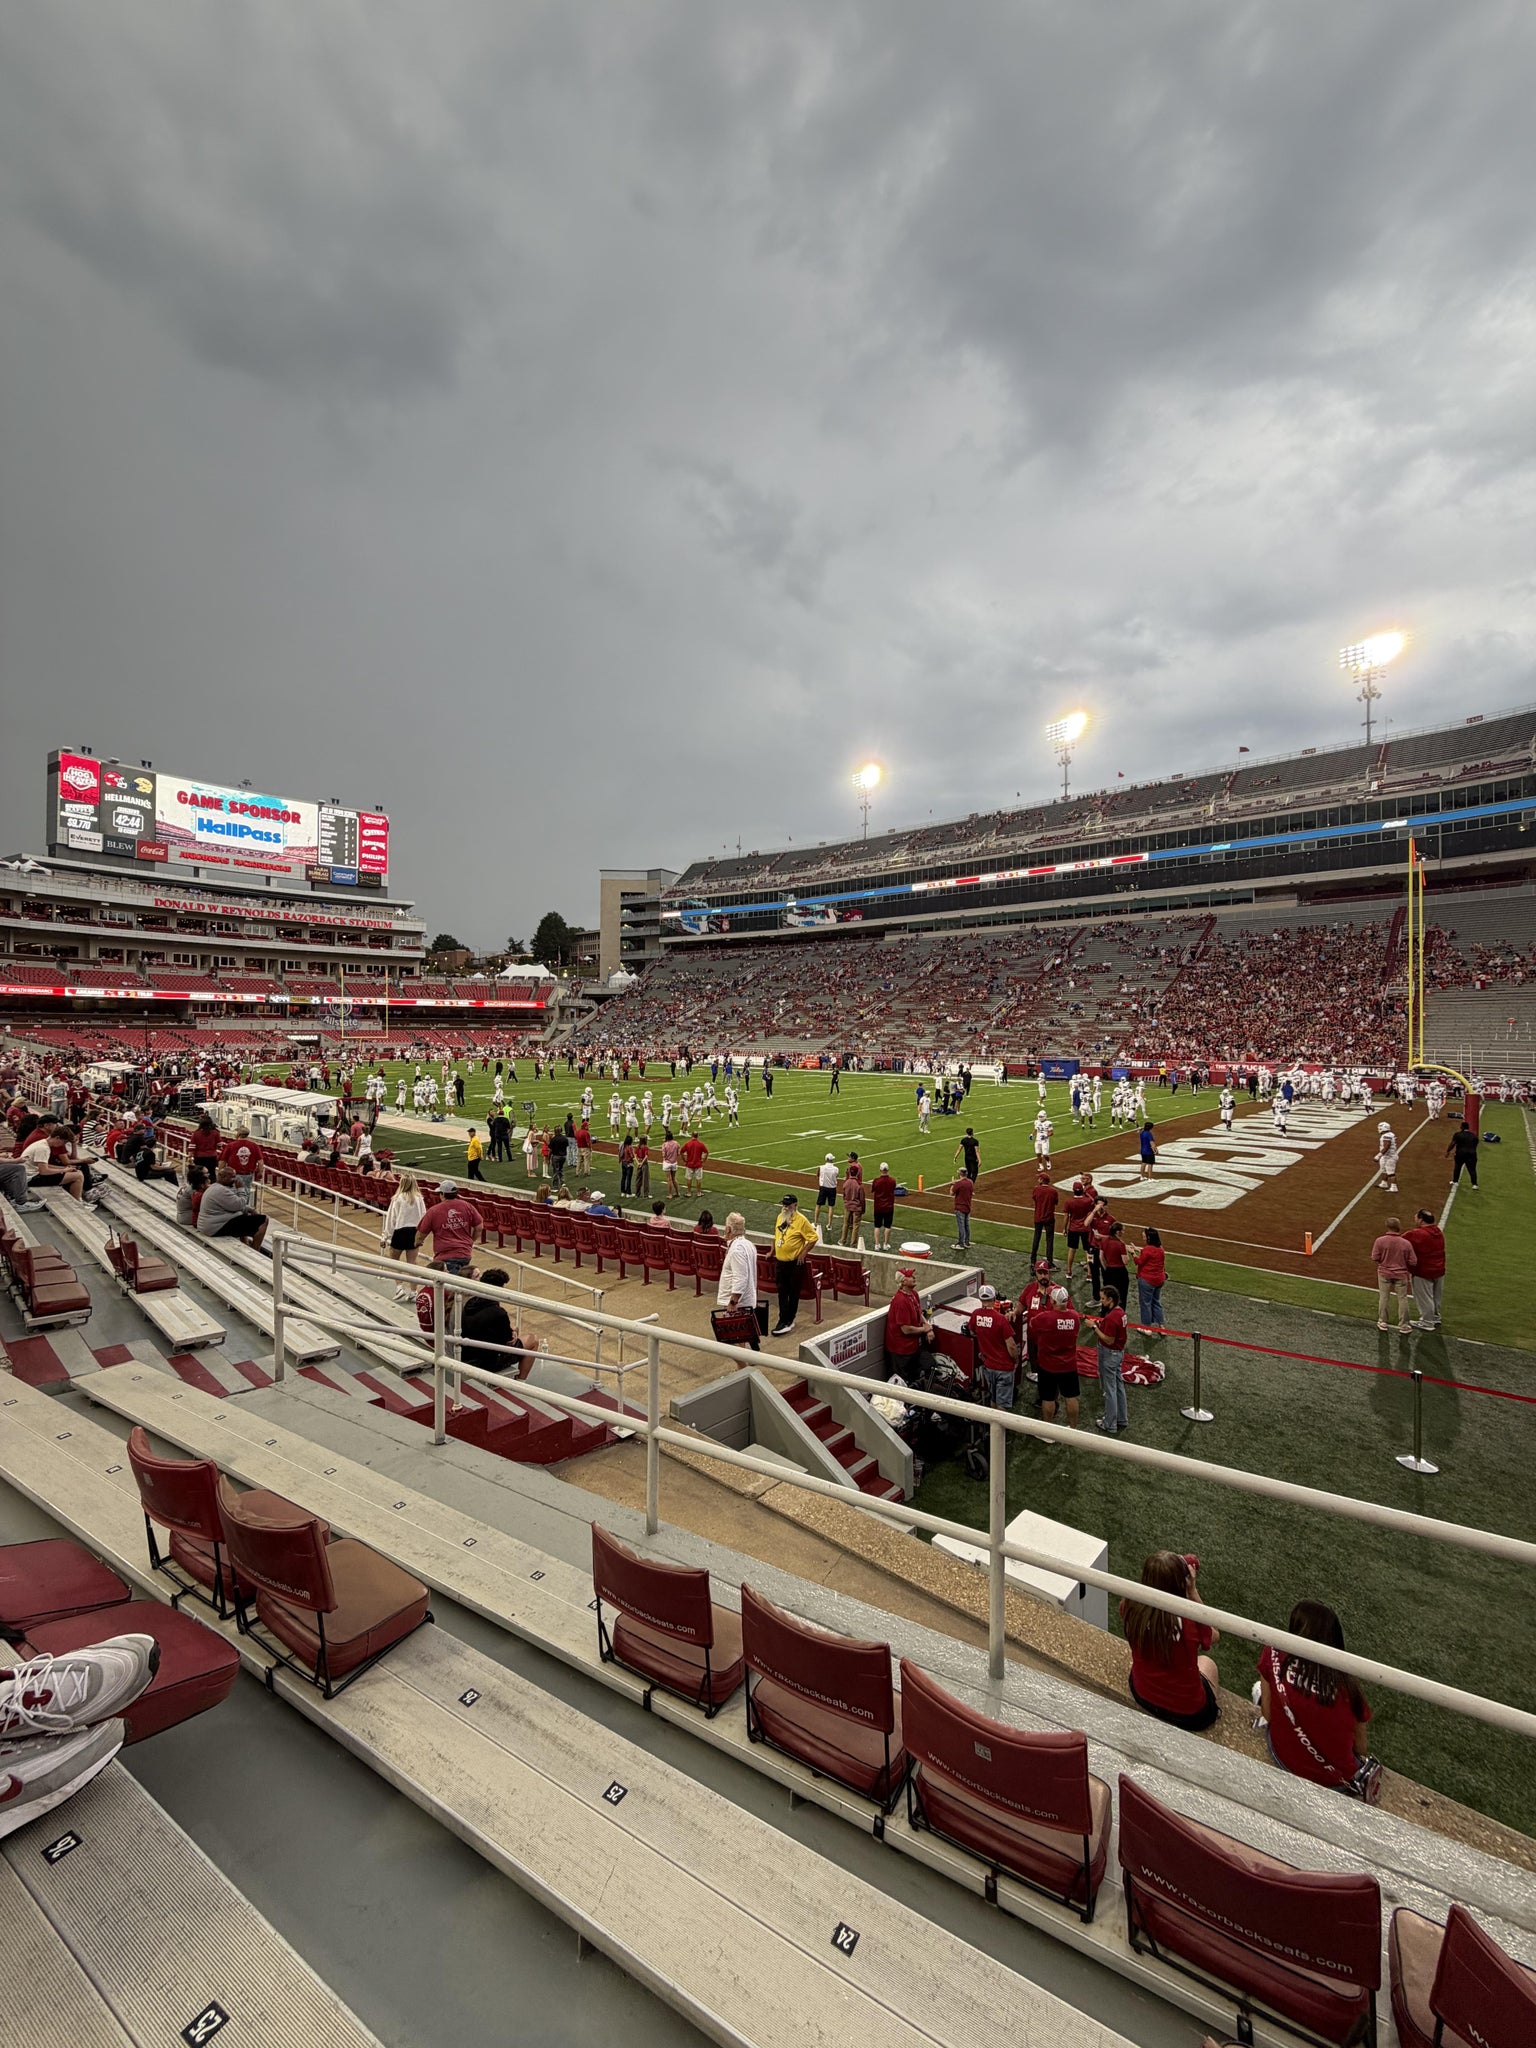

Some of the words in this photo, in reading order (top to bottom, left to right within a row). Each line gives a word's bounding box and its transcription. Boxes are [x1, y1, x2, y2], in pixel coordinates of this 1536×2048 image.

[65, 774, 96, 786] HEAVEN
[71, 769, 90, 779] HOG
[177, 791, 223, 811] GAME
[229, 800, 301, 824] SPONSOR
[116, 814, 140, 828] 42:44
[70, 833, 101, 843] EVERETT
[197, 817, 282, 844] HallPass
[106, 840, 134, 850] BLEW
[179, 851, 230, 864] ARKANSAS
[362, 853, 386, 861] PHILIPS
[154, 898, 206, 912] DONALD
[207, 904, 218, 913] W
[221, 906, 281, 919] REYNOLDS
[283, 912, 347, 926] RAZORBACK
[349, 918, 392, 929] STADIUM
[323, 1015, 358, 1028] Allstate
[976, 1315, 993, 1323] PYRO
[1056, 1318, 1075, 1326] PYRO
[600, 1585, 696, 1636] www.razorbackseats.com
[752, 1653, 875, 1720] www.razorbackseats.com
[462, 1691, 478, 1704] 26
[1294, 1726, 1326, 1764] WOOO
[606, 1785, 625, 1802] 25
[926, 1750, 1060, 1822] www.razorbackseats.com
[47, 1835, 77, 1860] 26
[1140, 1865, 1354, 1975] www.razorbackseats.com
[836, 1927, 855, 1950] 24
[189, 2009, 223, 2043] 25
